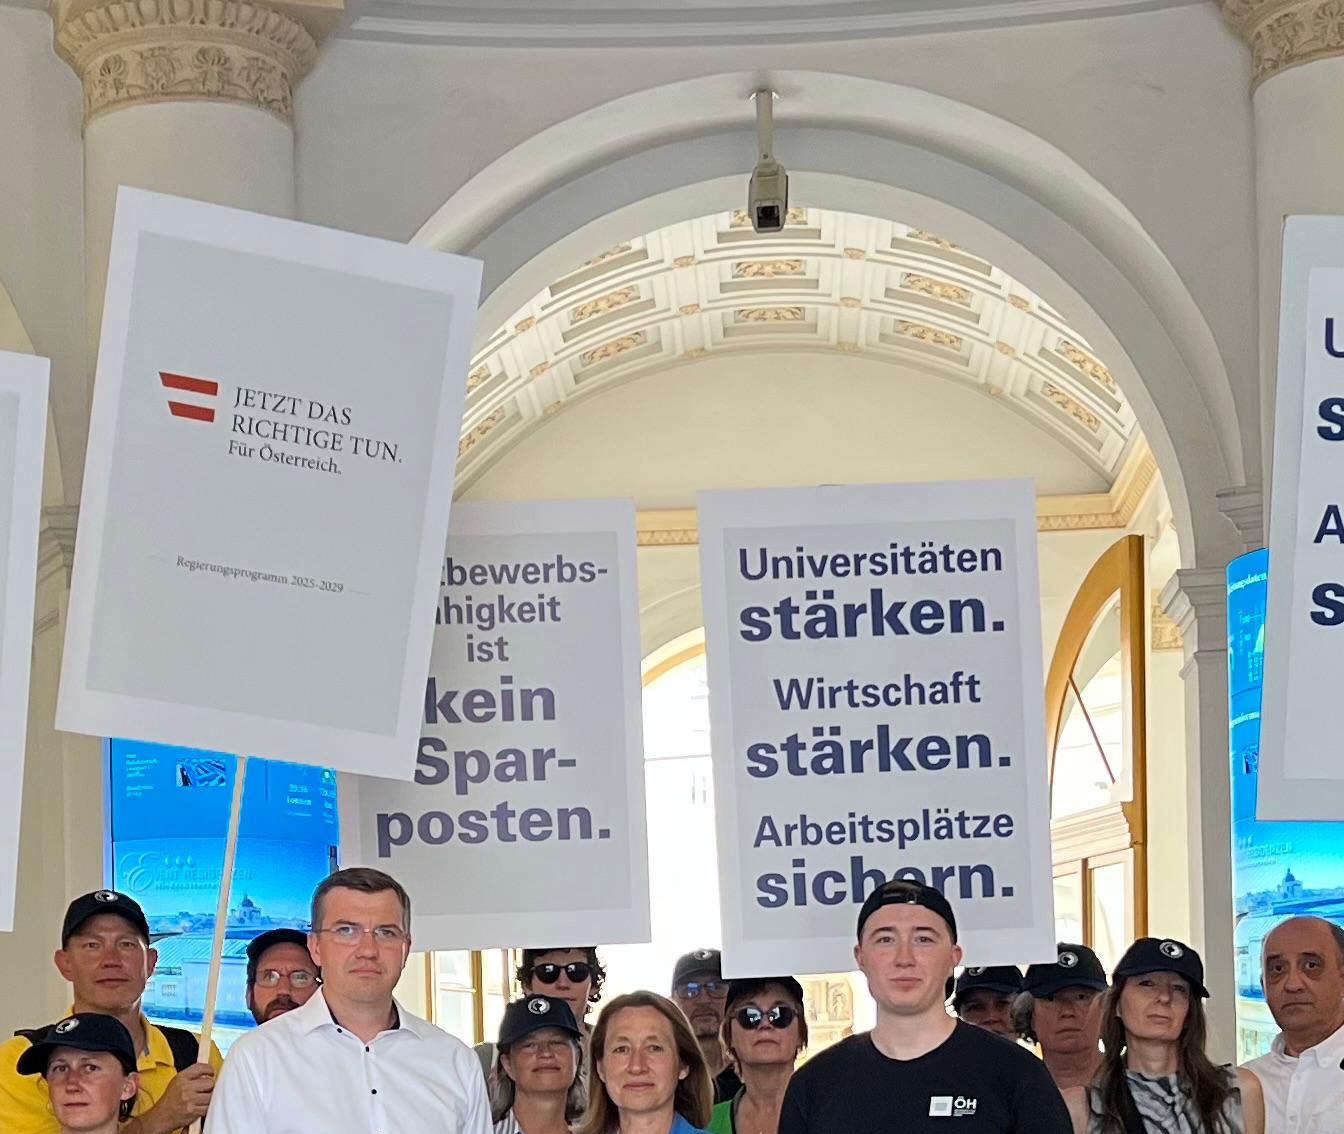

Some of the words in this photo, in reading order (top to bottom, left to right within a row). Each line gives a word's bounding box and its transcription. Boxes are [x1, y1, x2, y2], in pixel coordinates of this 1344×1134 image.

[233, 386, 302, 416] JETZT
[308, 401, 353, 426] DAS
[228, 440, 256, 458] Für
[259, 443, 343, 475] Österreich.
[231, 414, 344, 451] RICHTIGE
[349, 436, 403, 463] TUN.
[176, 555, 289, 585] Regierungsprogramm
[290, 575, 344, 593] 2025-2029
[440, 554, 609, 587] bewerbs-
[738, 541, 1003, 581] Universitäten
[739, 588, 1005, 642] stärken.
[466, 633, 509, 663] ist
[424, 675, 556, 724] kein
[772, 671, 982, 711] Wirtschaft
[414, 736, 577, 796] Spar-
[746, 724, 1012, 778] stärken.
[376, 800, 611, 858] posten.
[753, 808, 1015, 849] Arbeitsplätze
[954, 1095, 978, 1109] ÖH
